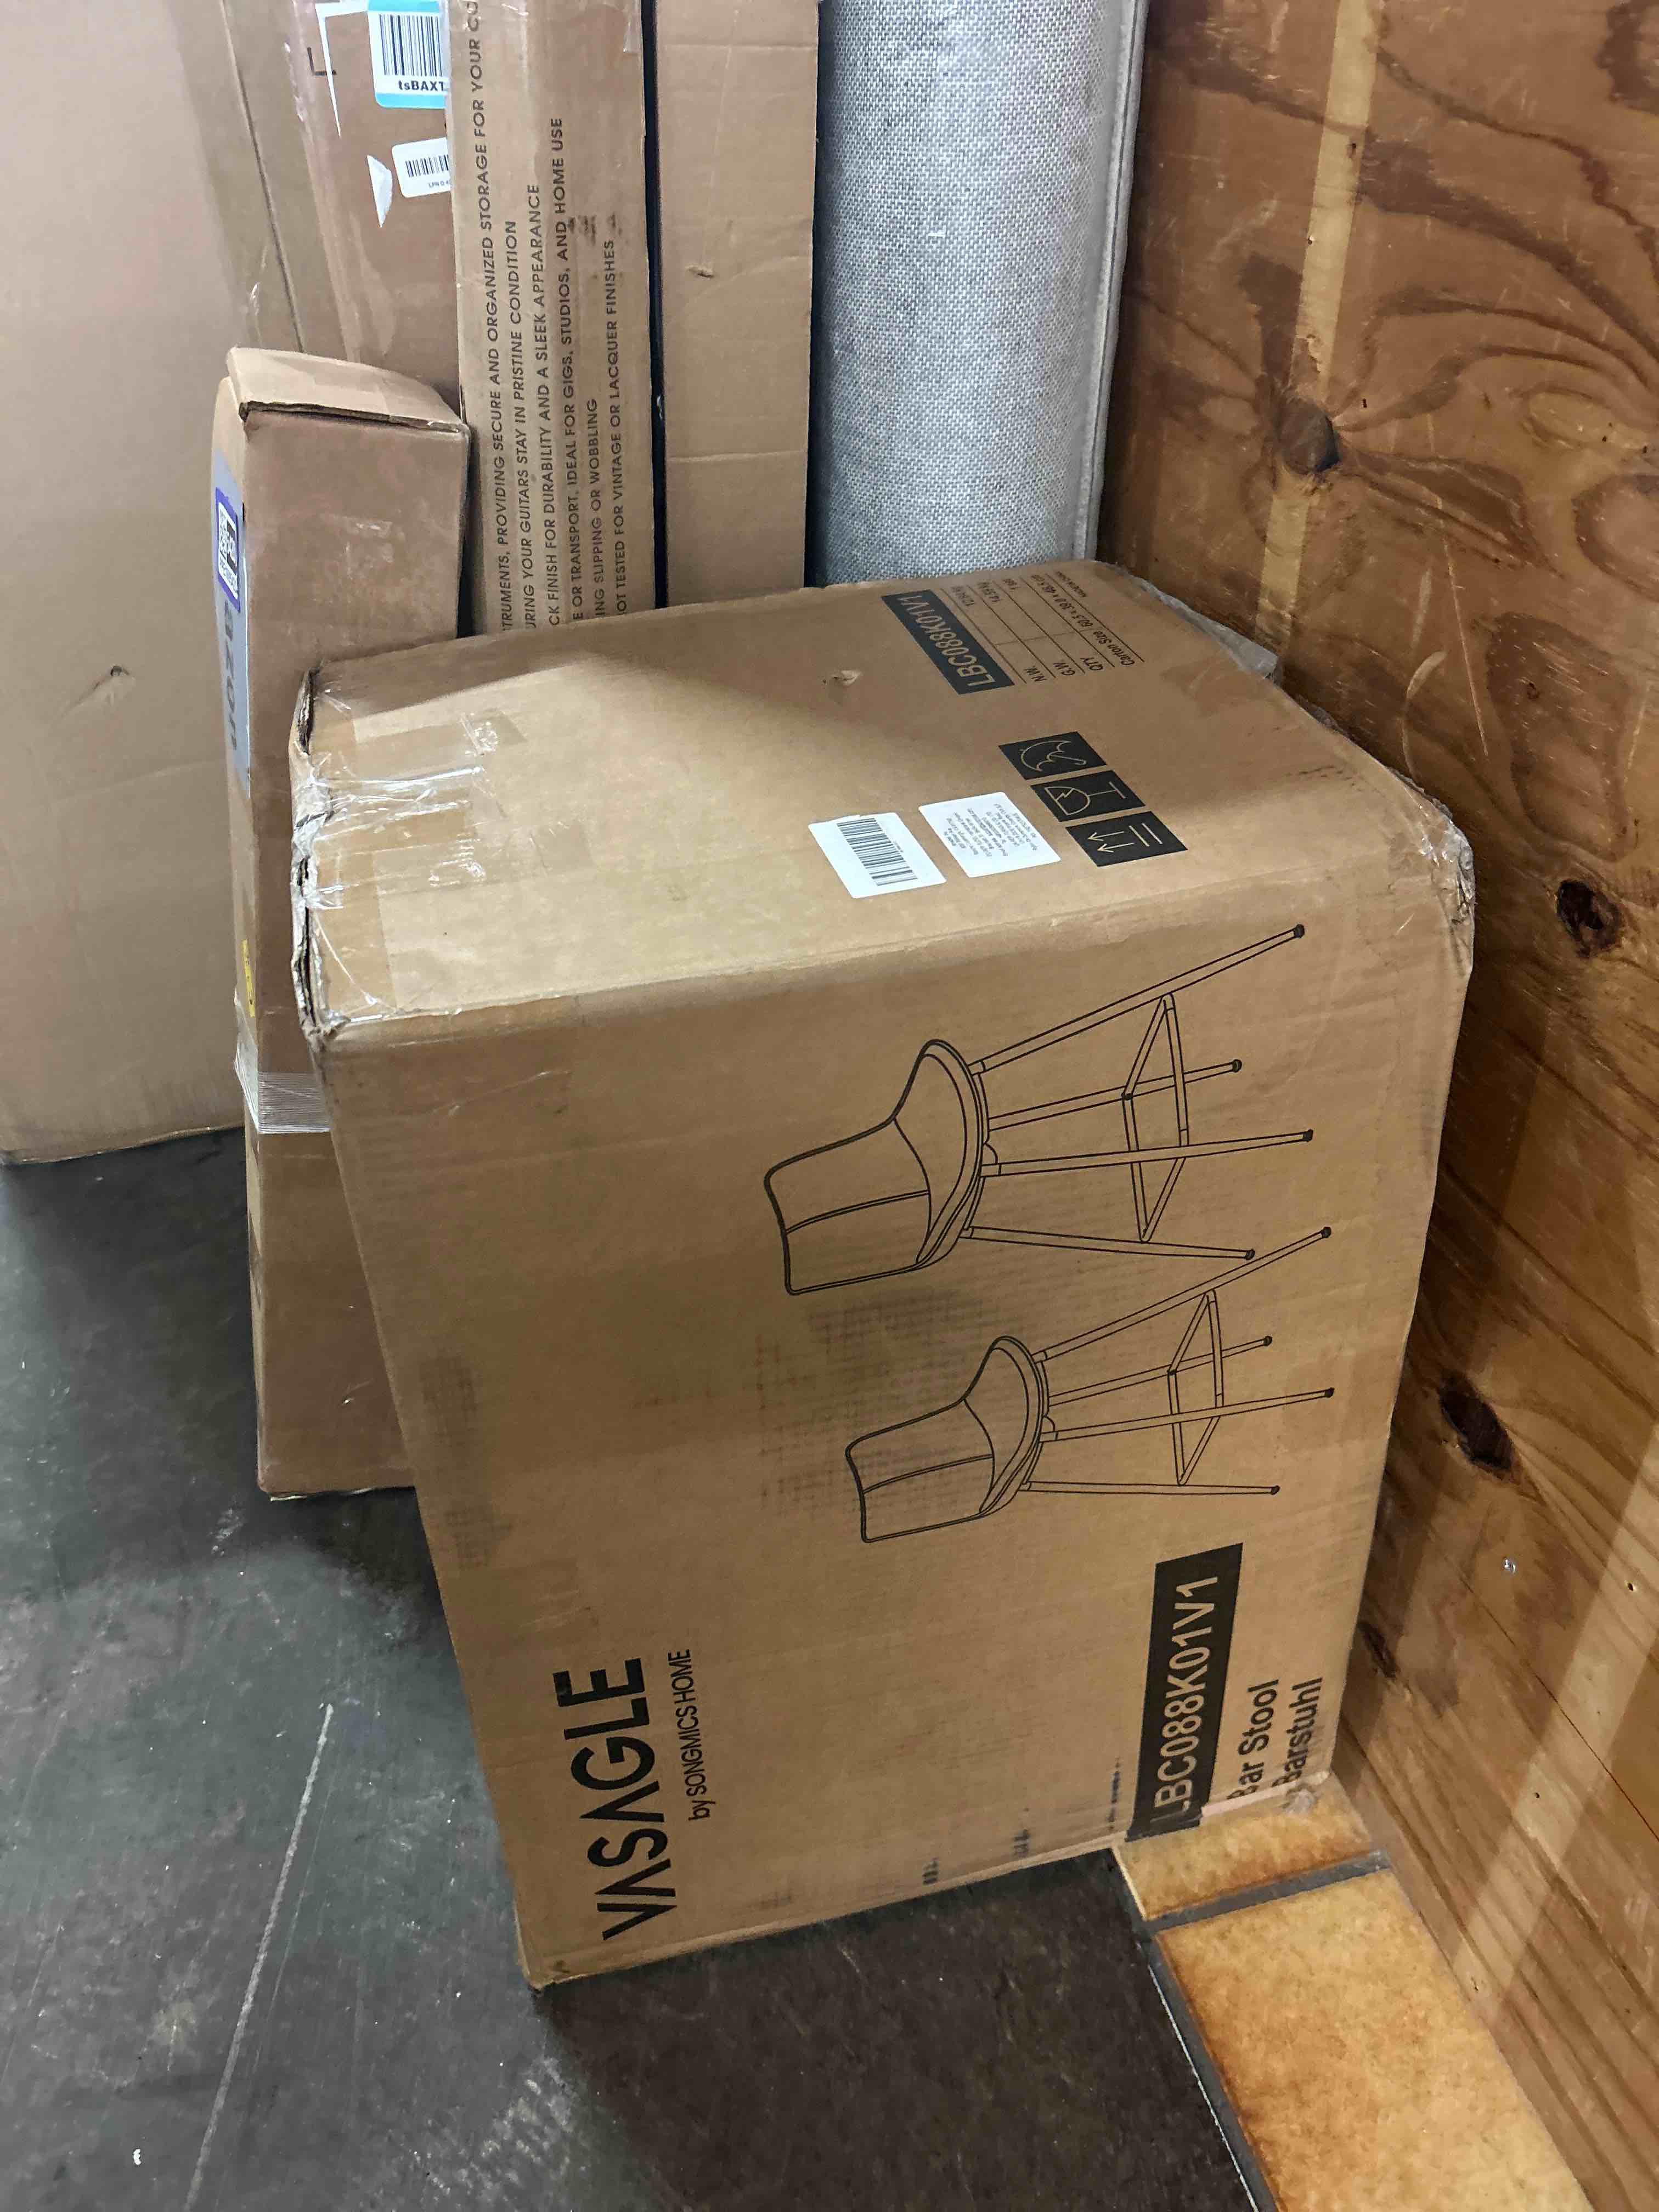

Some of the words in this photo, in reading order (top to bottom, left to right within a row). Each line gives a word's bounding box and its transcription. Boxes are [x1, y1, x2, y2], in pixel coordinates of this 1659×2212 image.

[469, 39, 483, 92] YOUR
[472, 100, 486, 137] FOR
[550, 118, 563, 151] USE
[475, 144, 492, 230] STORAGE
[552, 157, 566, 214] HOME
[527, 185, 545, 307] APPEARANCE
[555, 221, 568, 261] AND
[482, 237, 498, 342] ORGANIZED
[505, 221, 521, 324] CONDITION
[604, 240, 617, 315] FINISHES
[557, 268, 572, 345] STUDIOS,
[534, 313, 548, 360] SLEEK
[606, 320, 620, 399] LACQUER
[488, 348, 500, 385] AND
[511, 331, 525, 400] PRISTINE
[537, 367, 549, 378] A
[489, 391, 504, 450] SECURE
[515, 407, 526, 424] IN
[536, 384, 551, 421] AND
[564, 404, 575, 436] FOR
[610, 404, 620, 427] OR
[515, 429, 527, 464] STAY
[565, 441, 577, 486] IDEAL
[586, 398, 600, 484] WOBBLING
[539, 427, 555, 513] DURABILITY
[611, 433, 623, 500] VINTAGE
[494, 456, 509, 545] PROVIDING
[517, 470, 531, 533] GUITARS
[590, 490, 601, 511] OR
[613, 505, 624, 535] FOR
[544, 519, 556, 549] FOR
[592, 517, 604, 582] SLIPPING
[521, 539, 534, 579] YOUR
[545, 554, 559, 600] FINISH
[614, 540, 626, 589] TESTED
[496, 551, 512, 631] TRUMENTS,
[572, 586, 583, 607] OR
[594, 589, 605, 618] ING
[617, 596, 627, 615] OT
[549, 605, 560, 625] CK
[1093, 630, 1112, 645] Size
[897, 595, 996, 687] LBC088K01V1
[1080, 657, 1103, 671] QTY
[1107, 644, 1135, 665] Carton
[1238, 1679, 1279, 1756] Stool
[1272, 1677, 1323, 1787] Barstuhl
[552, 1657, 678, 1940] VASAGLE
[688, 1799, 715, 1821] by
